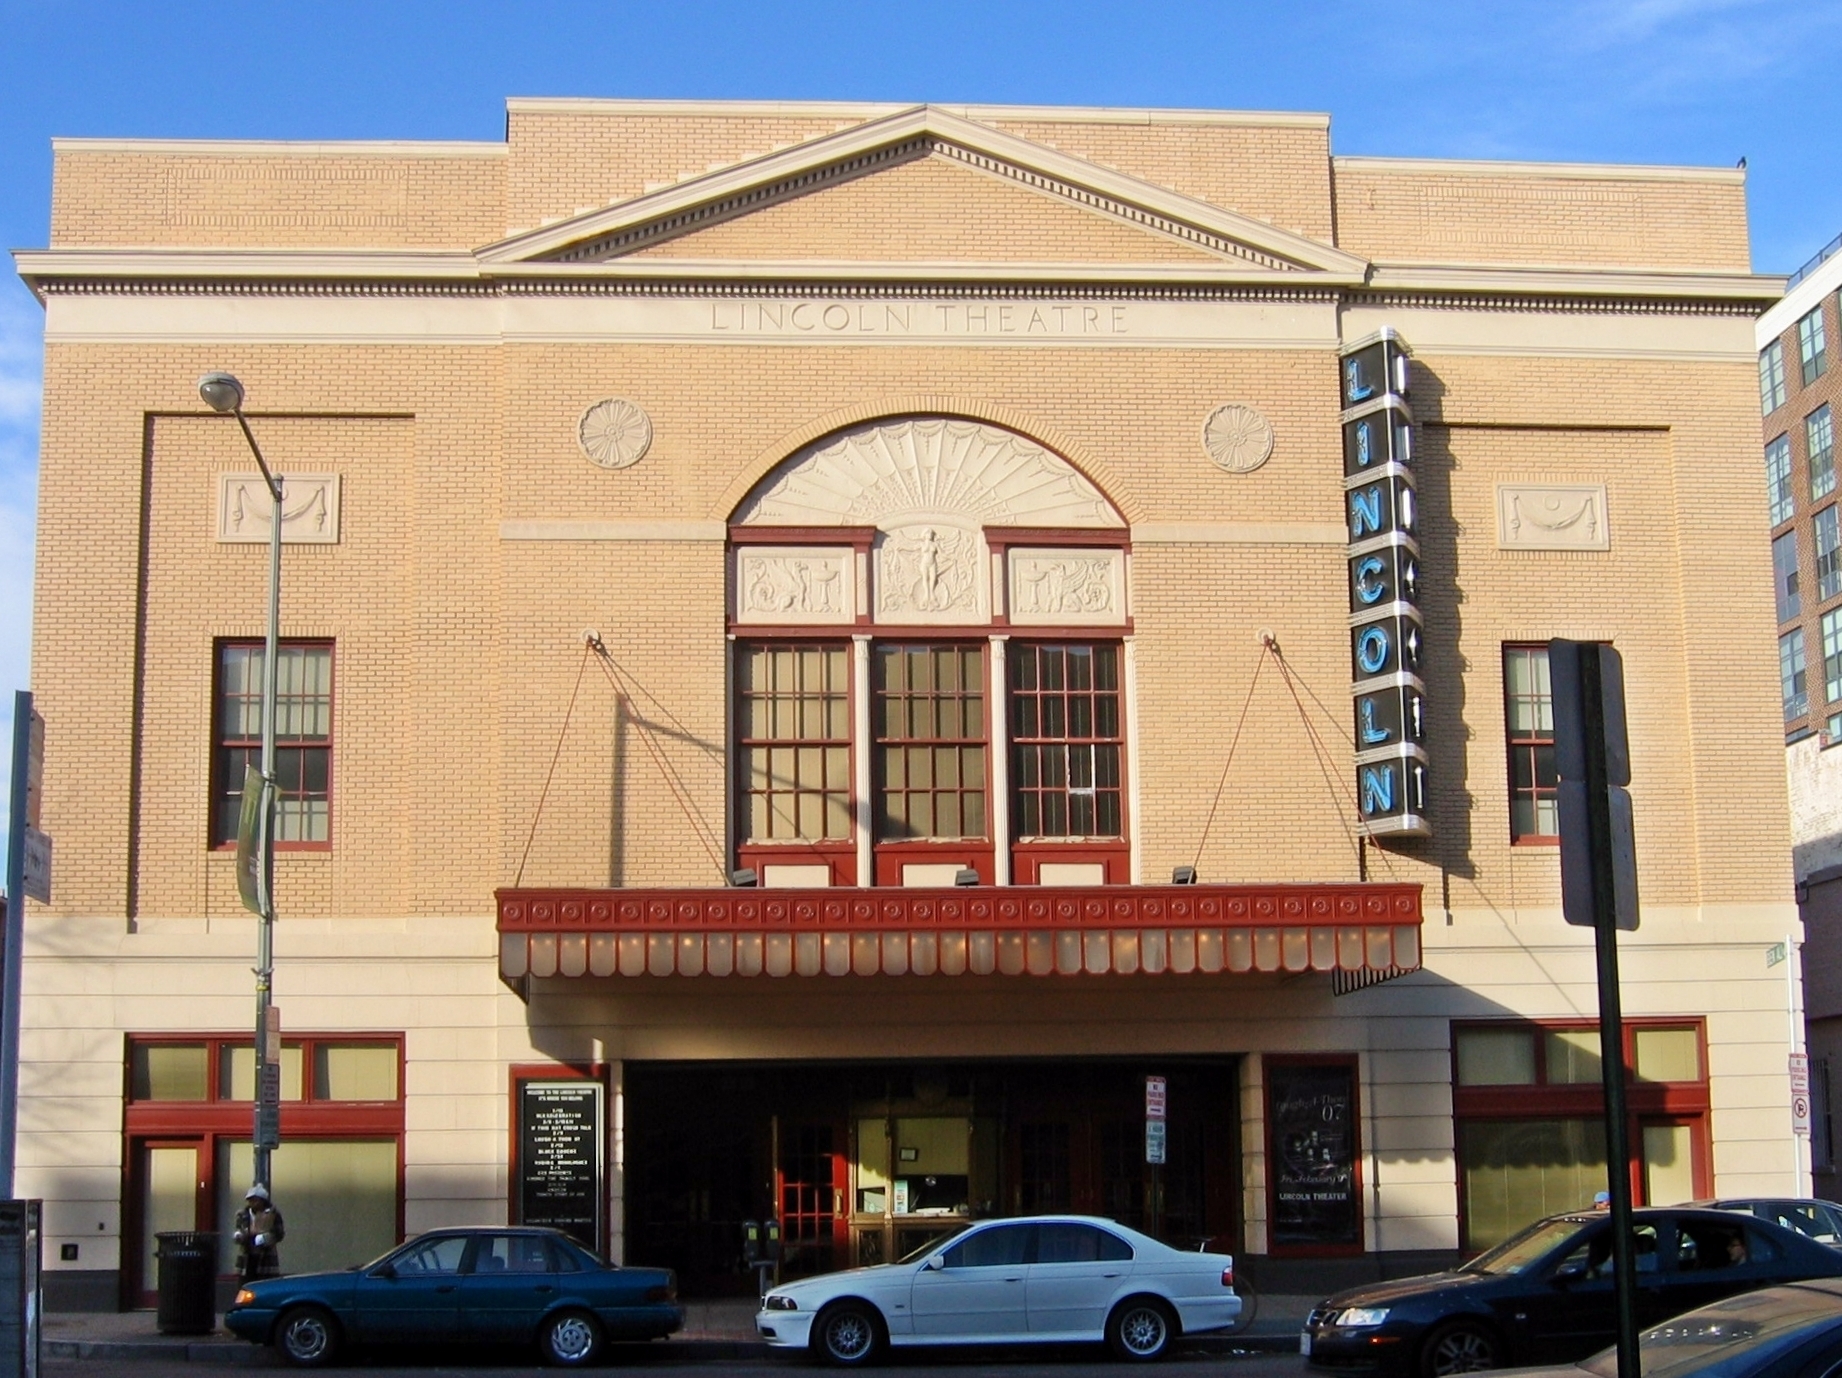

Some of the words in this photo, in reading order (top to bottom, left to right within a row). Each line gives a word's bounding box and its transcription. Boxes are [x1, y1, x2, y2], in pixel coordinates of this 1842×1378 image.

[710, 302, 911, 332] LINCOLN
[935, 304, 1130, 334] THEATRE
[1346, 357, 1393, 814] LINCOLN
[1279, 1192, 1311, 1201] LINCOLN
[1313, 1192, 1347, 1201] THEATER
